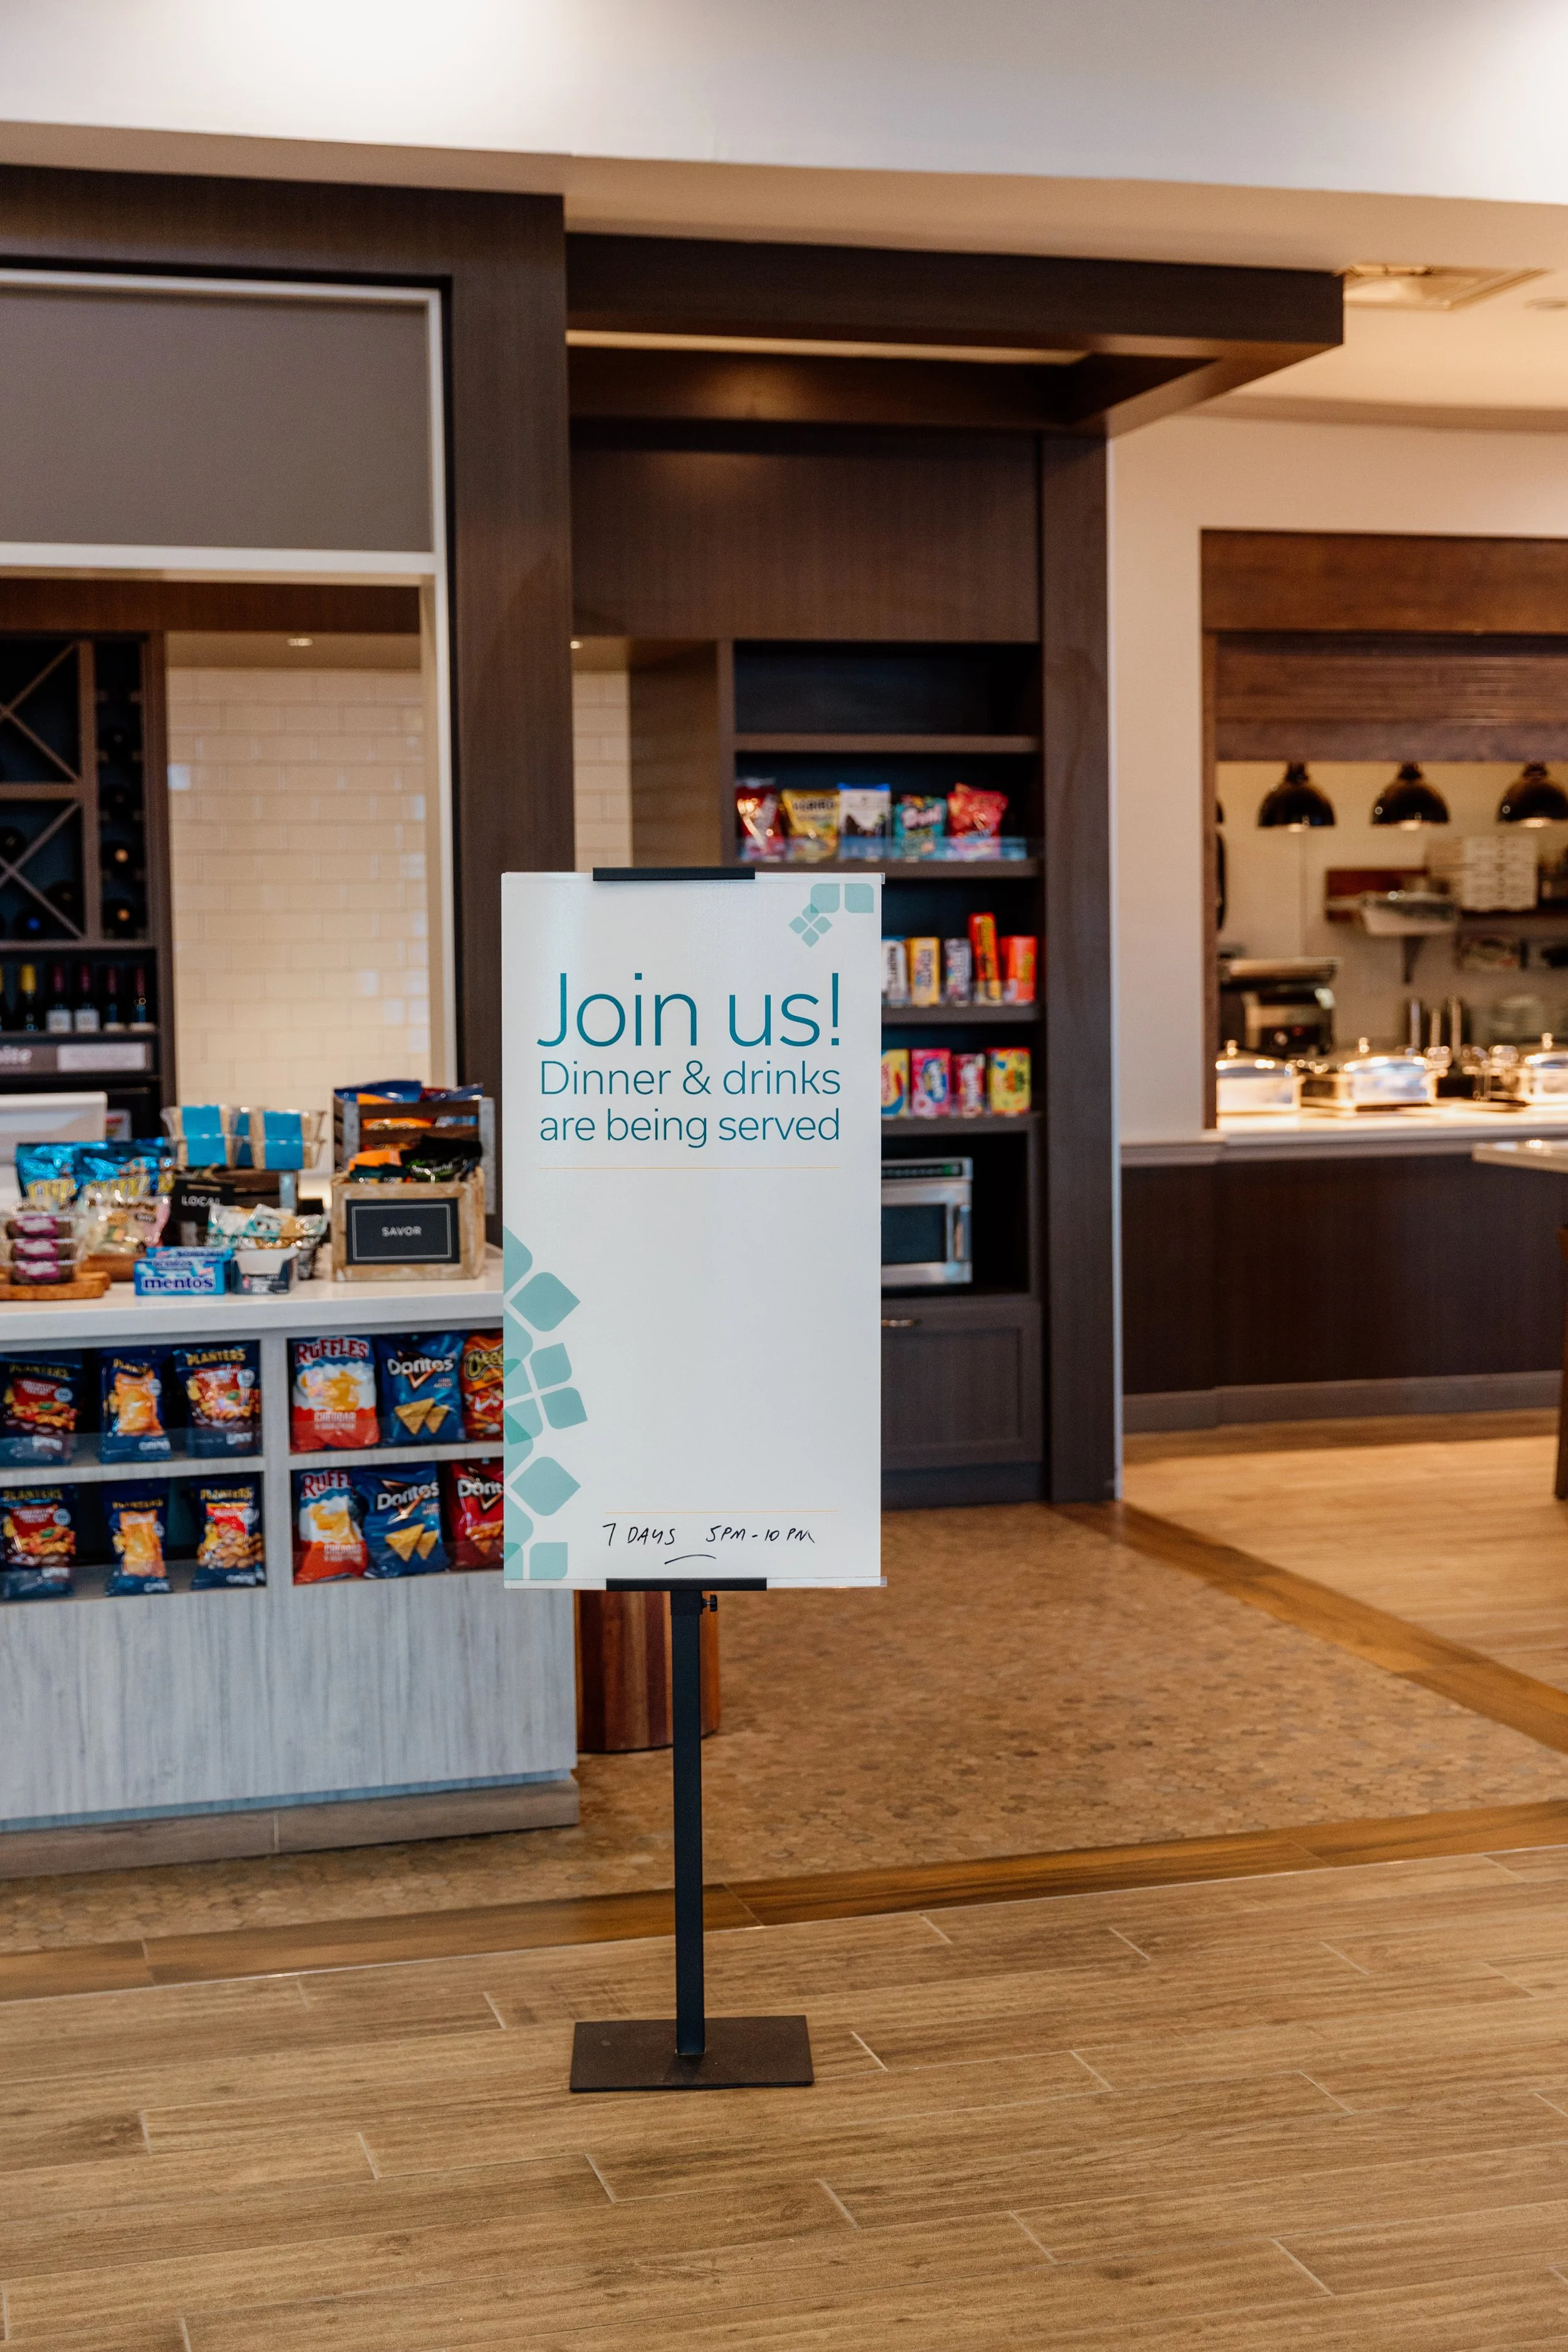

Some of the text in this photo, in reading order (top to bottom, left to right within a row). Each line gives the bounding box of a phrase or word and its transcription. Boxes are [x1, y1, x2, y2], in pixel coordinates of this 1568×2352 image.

[536, 972, 840, 1047] Join us!
[541, 1061, 672, 1095] Dinner
[682, 1060, 712, 1095] &
[723, 1060, 841, 1095] drinks
[540, 1108, 839, 1148] are being served
[381, 1226, 422, 1237] SAVOR
[144, 1276, 214, 1289] mentos
[186, 1350, 247, 1365] PLANTERS
[295, 1338, 369, 1364] RUFFLES
[387, 1359, 454, 1375] Doritos
[377, 1481, 439, 1510] Doritos
[602, 1522, 617, 1547] 7
[627, 1526, 675, 1545] DAYS
